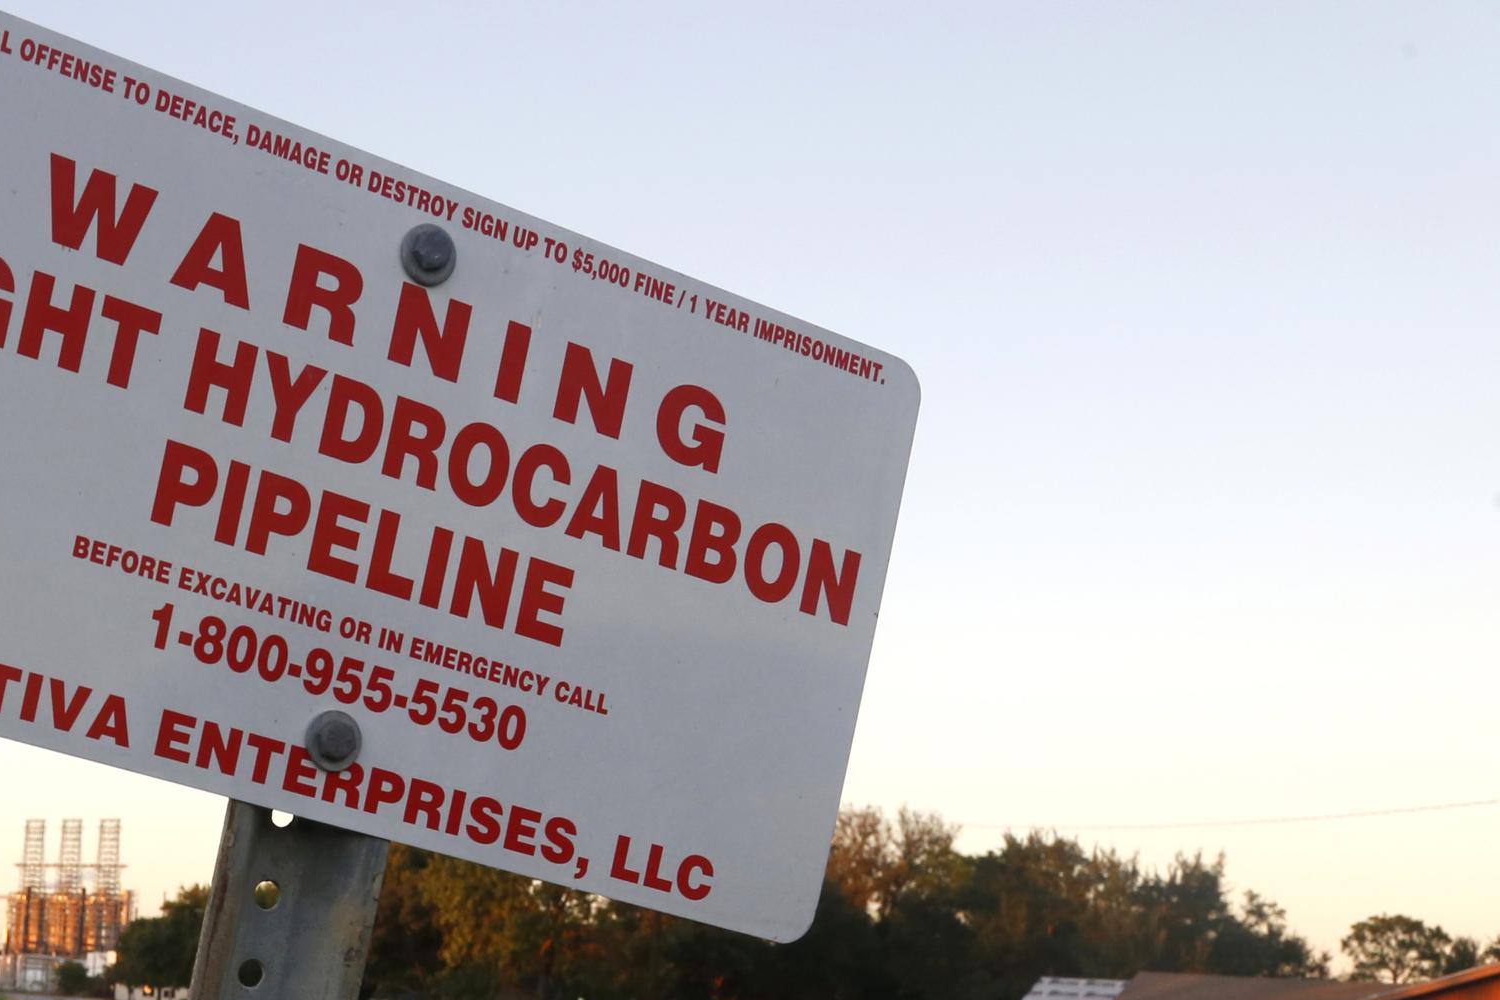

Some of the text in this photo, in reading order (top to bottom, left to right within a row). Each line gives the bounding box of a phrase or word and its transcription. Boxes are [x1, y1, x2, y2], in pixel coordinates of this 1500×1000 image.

[19, 38, 117, 93] OFFENSE
[122, 75, 151, 106] TO
[155, 89, 240, 145] DEFACE,
[246, 124, 331, 175] DAMAGE
[335, 159, 364, 188] OR
[368, 171, 459, 221] DESTROY
[462, 207, 509, 242] SIGN
[512, 225, 540, 251] UP
[544, 236, 568, 264] TO
[572, 248, 631, 288] $5,000
[634, 272, 677, 305] FINE
[677, 289, 687, 310] /
[690, 295, 699, 314] 1
[705, 300, 751, 334] YEAR
[754, 318, 888, 385] IMPRISONMENT.
[50, 152, 727, 475] WARNING
[150, 439, 577, 648] PIPELINE
[183, 327, 863, 627] HYDROCARBON
[72, 535, 609, 717] BEFORE EXCAVATING OR IN EMERGENCY CALL
[151, 602, 528, 752] 1-800-955-5530
[153, 709, 594, 882] ENTERPRISES,
[610, 833, 717, 902] LLC
